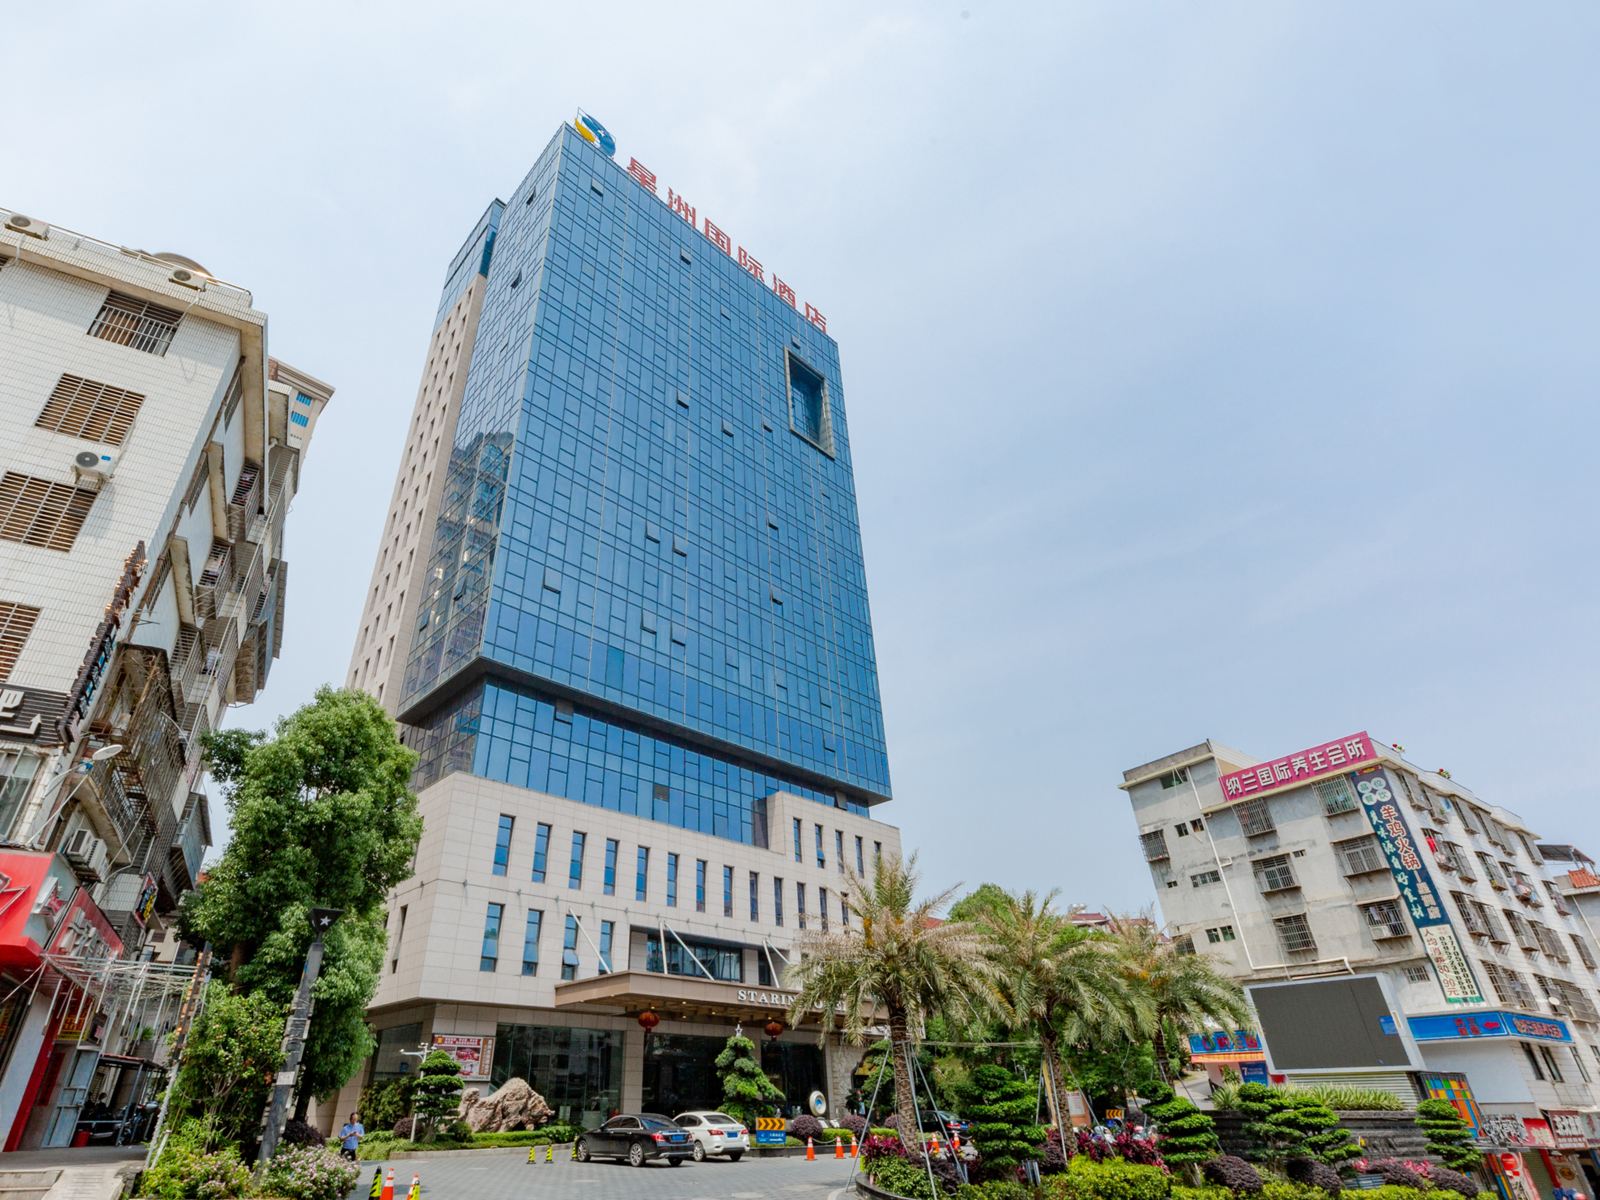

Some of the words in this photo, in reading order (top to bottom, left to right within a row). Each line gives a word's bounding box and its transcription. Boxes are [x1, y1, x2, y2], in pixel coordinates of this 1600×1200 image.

[627, 157, 827, 333] 星洲国际酒店
[1225, 737, 1367, 796] 纳兰国际养生会所
[1380, 804, 1422, 871] 羊鸡火锅
